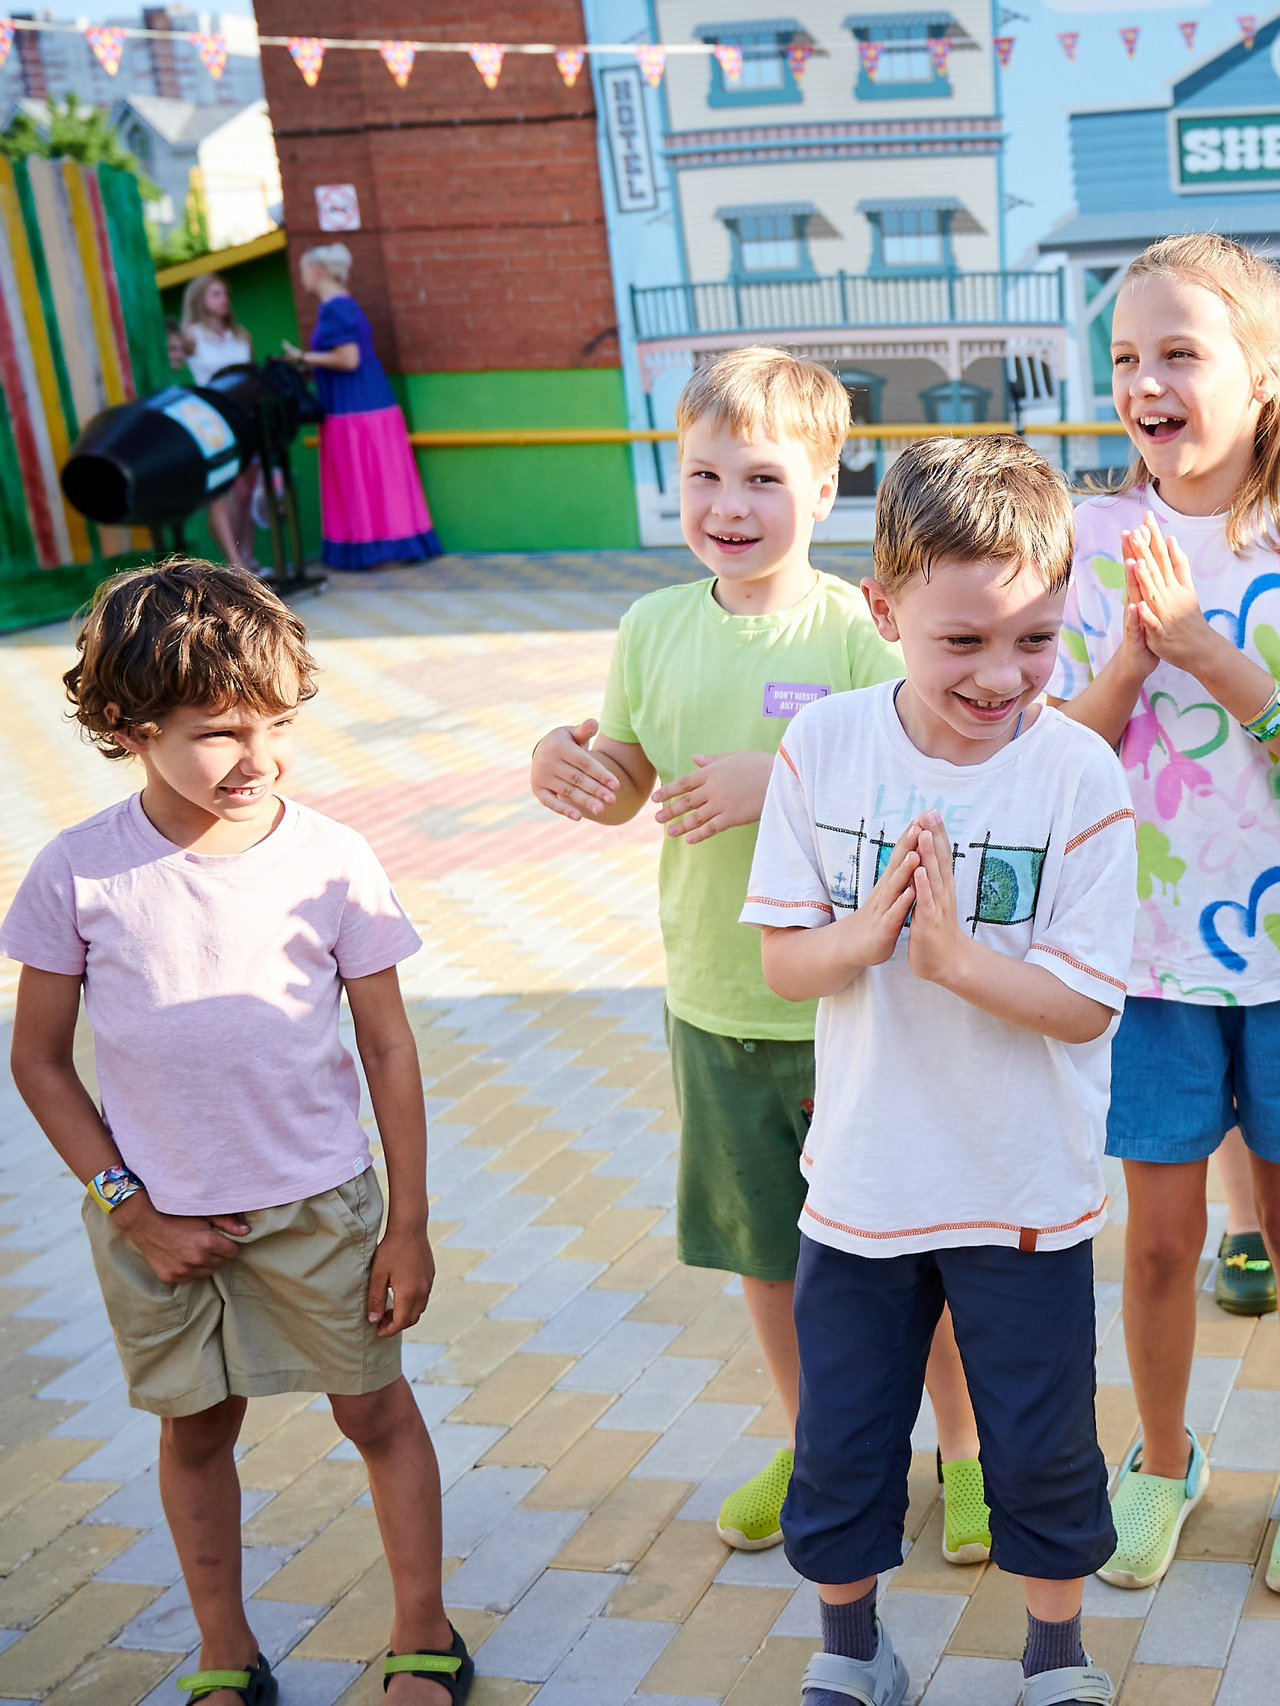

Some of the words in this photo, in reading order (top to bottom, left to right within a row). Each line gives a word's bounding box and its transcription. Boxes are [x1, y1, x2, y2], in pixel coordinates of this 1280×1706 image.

[613, 80, 647, 199] HOTEL
[774, 690, 794, 700] DON'T
[780, 701, 794, 710] ANY
